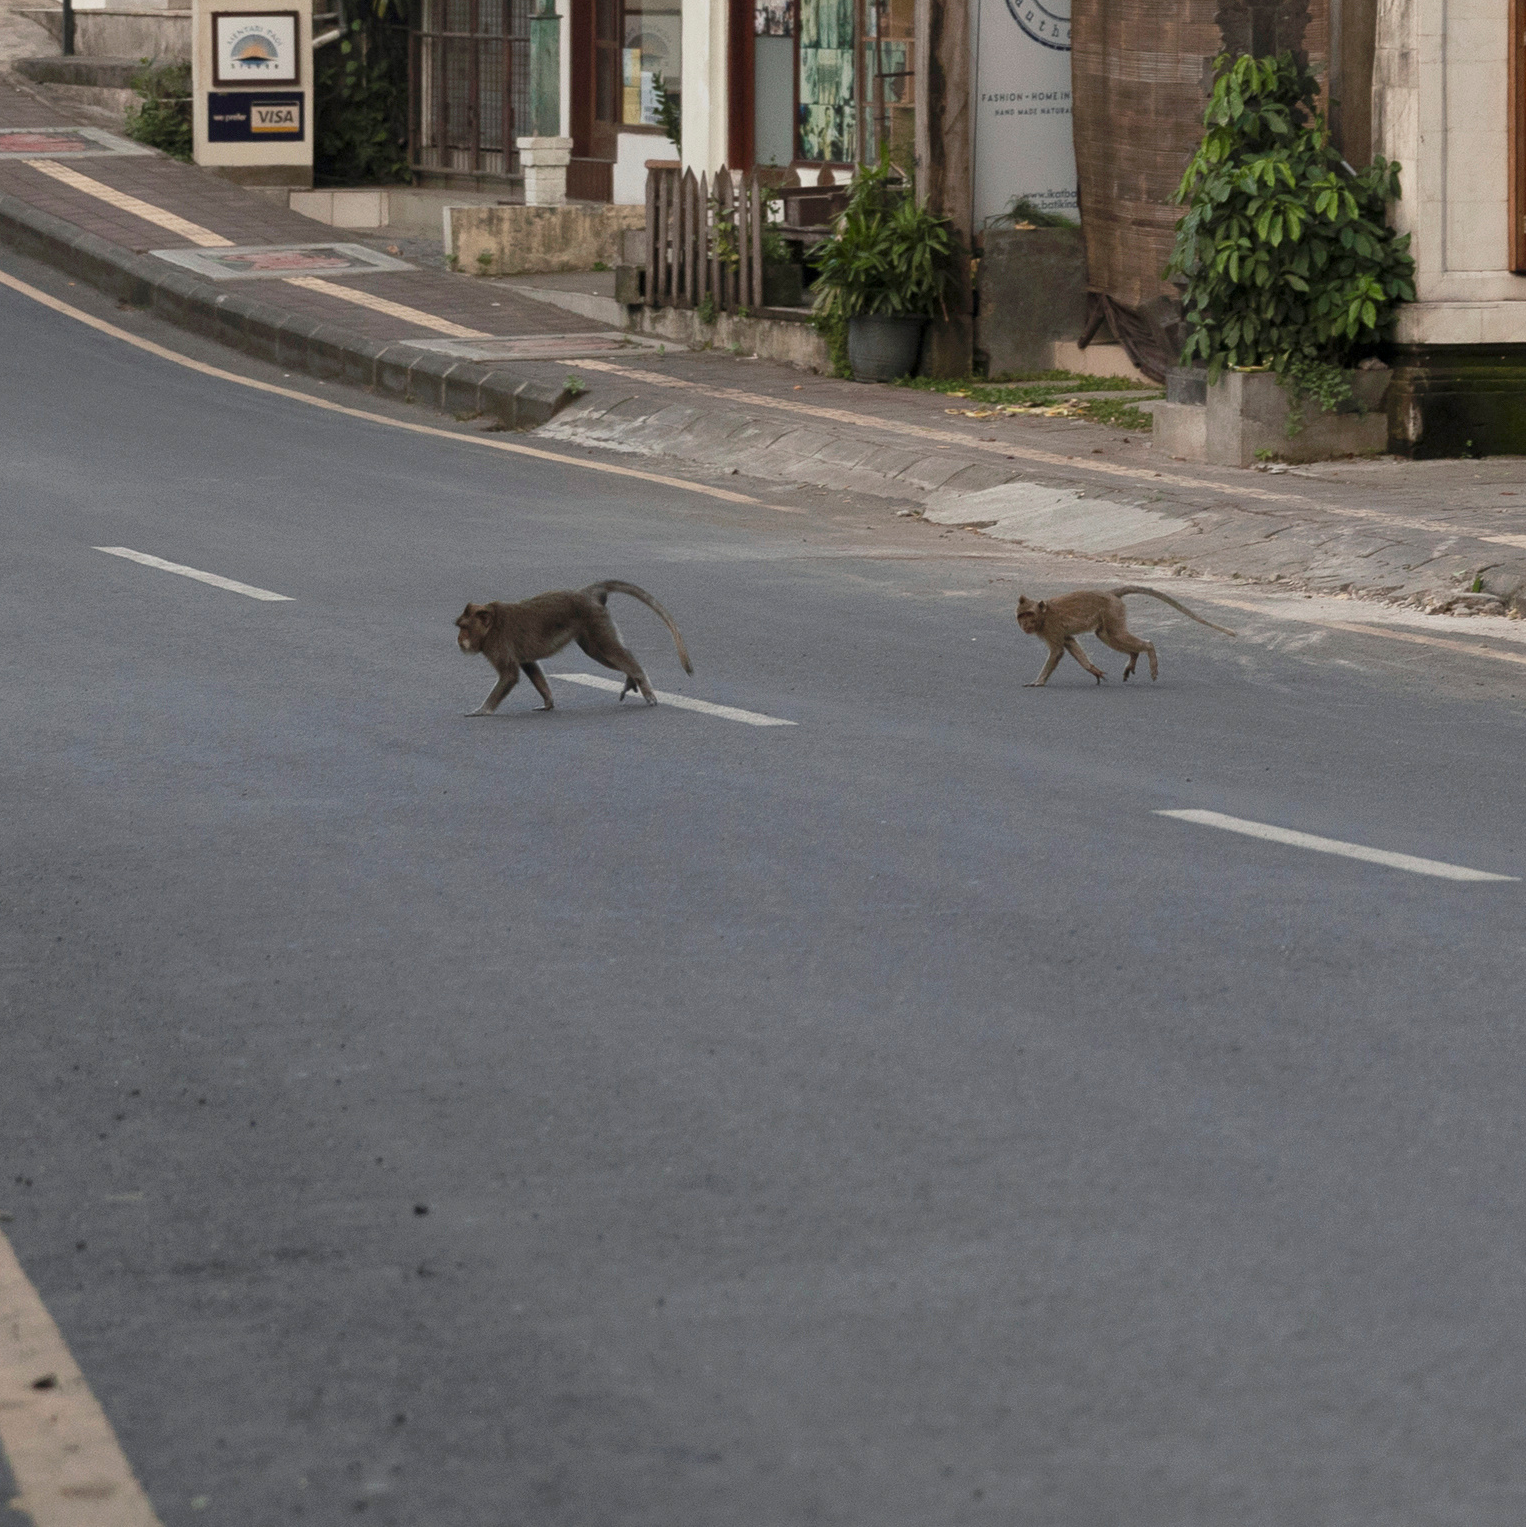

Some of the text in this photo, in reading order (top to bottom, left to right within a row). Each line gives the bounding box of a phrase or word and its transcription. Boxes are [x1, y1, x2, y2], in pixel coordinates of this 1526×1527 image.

[981, 93, 1023, 103] FASHION
[1031, 92, 1058, 102] HOME
[257, 110, 295, 123] VISA
